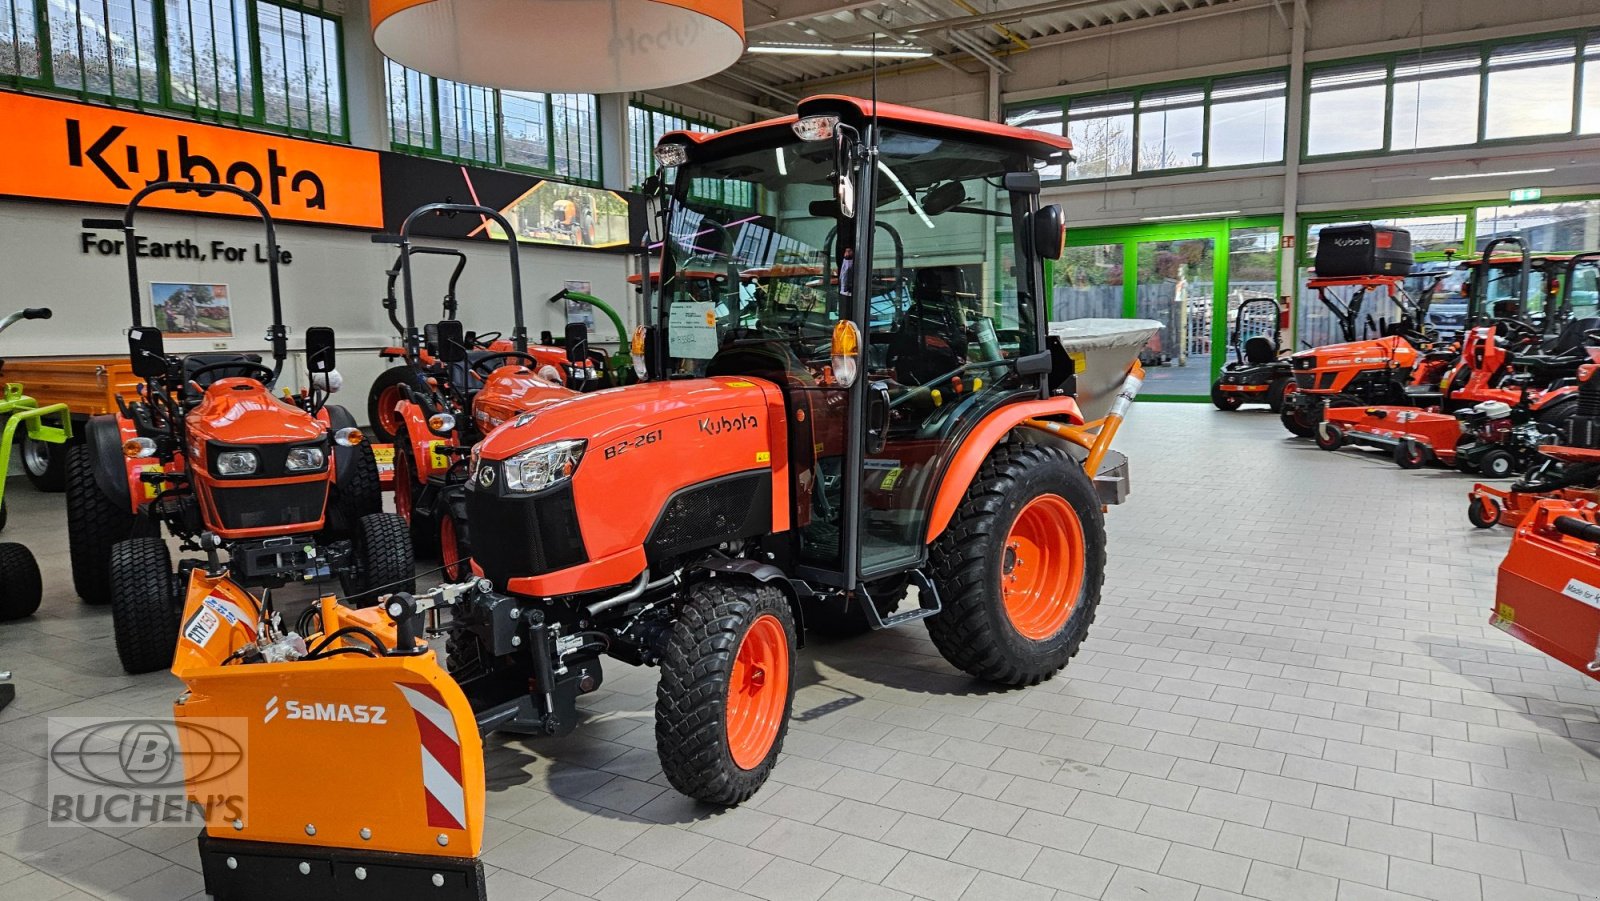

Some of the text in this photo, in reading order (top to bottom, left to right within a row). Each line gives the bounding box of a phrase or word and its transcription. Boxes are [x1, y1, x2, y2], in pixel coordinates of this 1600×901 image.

[66, 118, 326, 210] Kubota
[81, 232, 124, 255] For
[134, 236, 206, 262] Earth,
[210, 241, 247, 262] For
[1334, 237, 1370, 247] Kubota
[698, 413, 758, 436] Kubota
[605, 429, 663, 460] B2-261
[285, 700, 388, 725] SaMASZ
